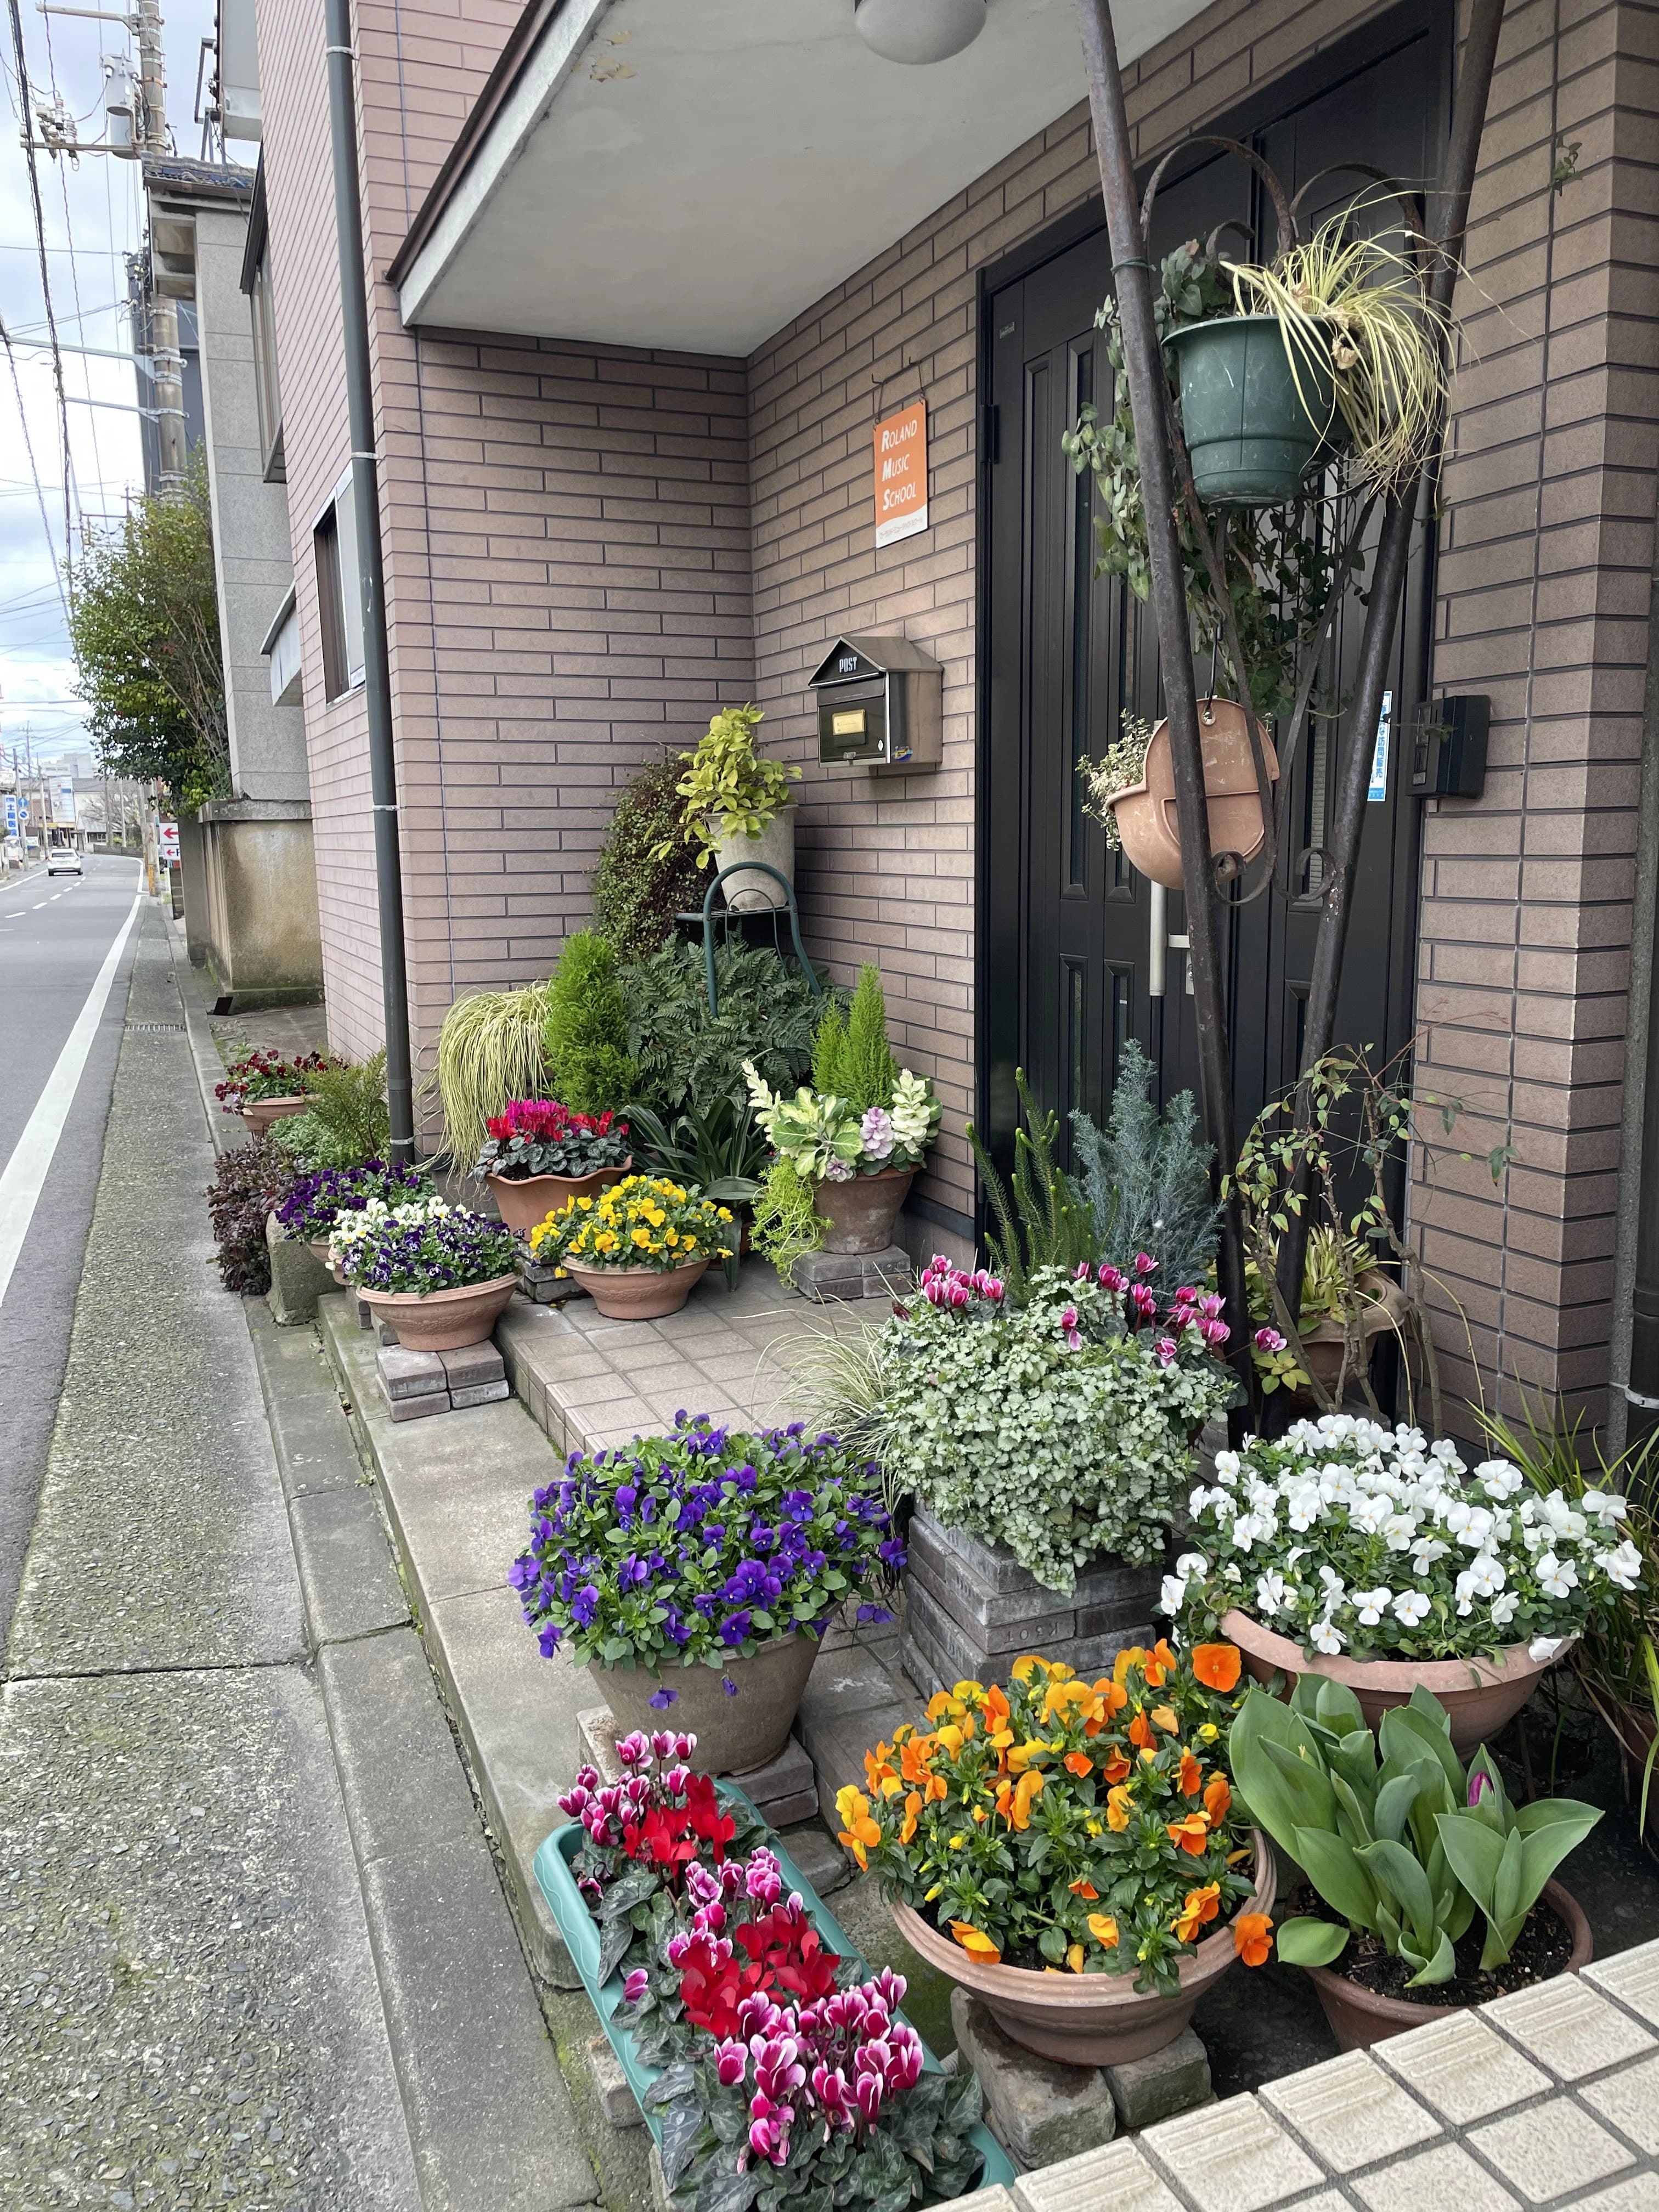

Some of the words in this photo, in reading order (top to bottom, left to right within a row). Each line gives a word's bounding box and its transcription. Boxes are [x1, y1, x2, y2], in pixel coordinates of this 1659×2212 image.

[881, 420, 917, 453] ROLAND
[882, 454, 910, 482] MUSIC
[882, 481, 916, 511] SCHOOL
[839, 657, 857, 673] POST
